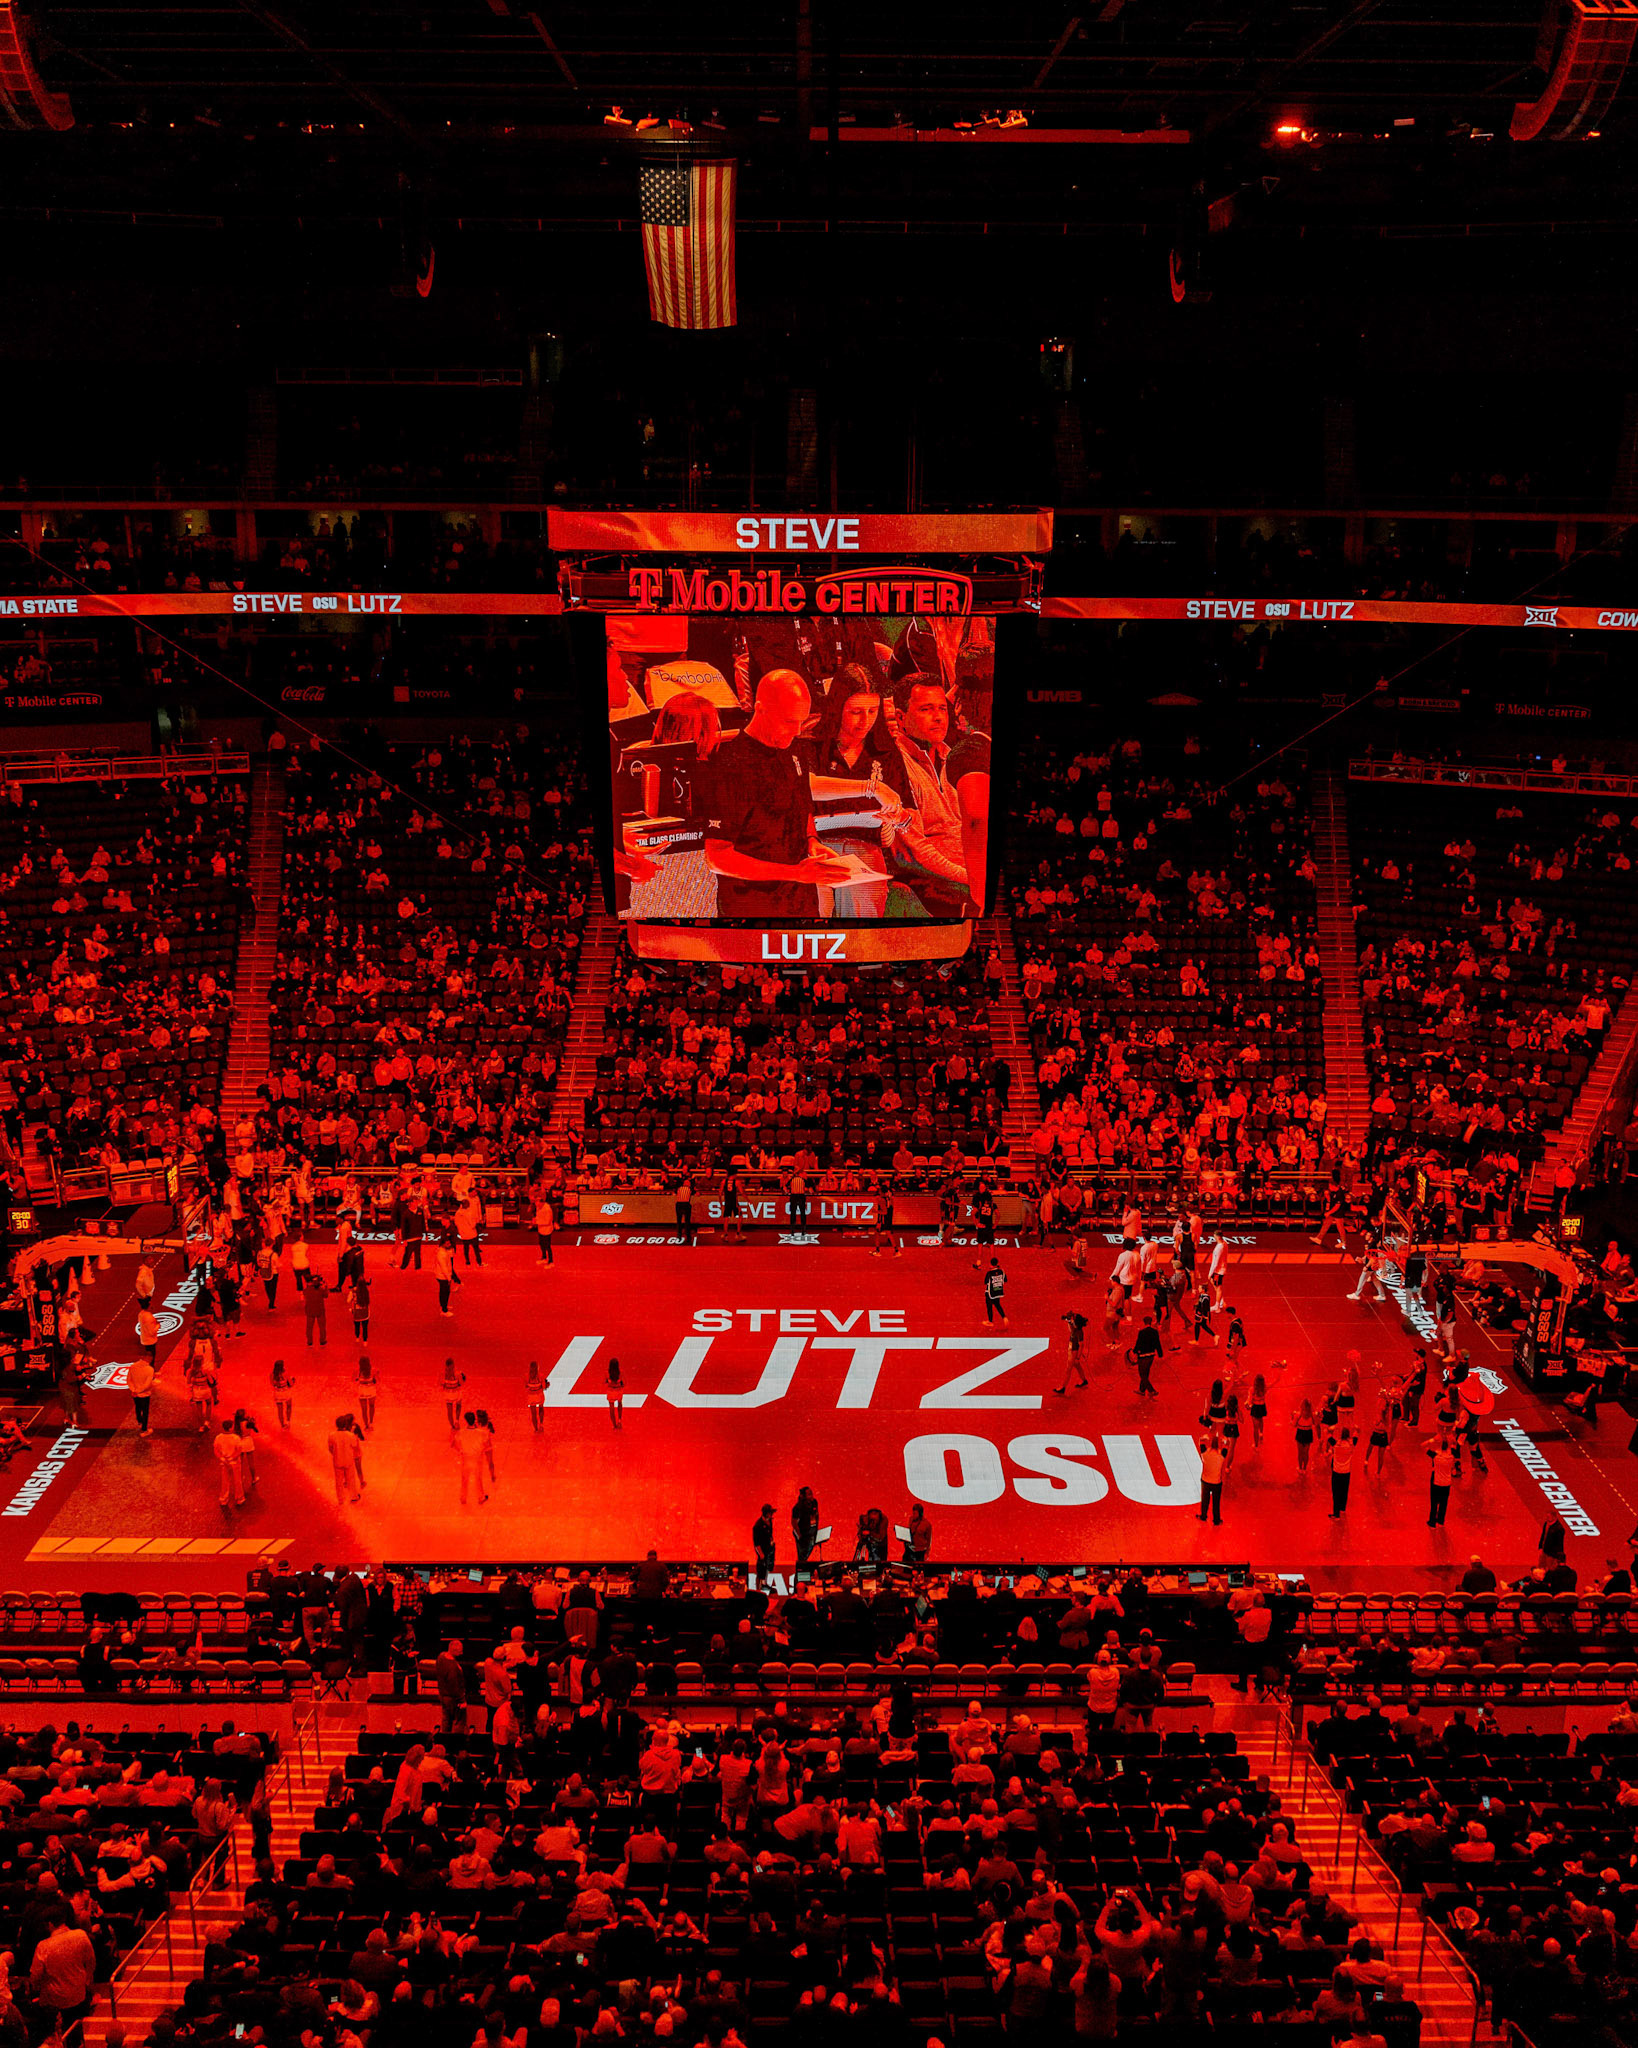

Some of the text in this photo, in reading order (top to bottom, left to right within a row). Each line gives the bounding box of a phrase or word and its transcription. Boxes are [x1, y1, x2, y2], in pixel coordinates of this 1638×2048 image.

[737, 518, 859, 549] STEVE
[669, 569, 806, 612] Mobile
[815, 581, 961, 613] CENTER
[23, 599, 78, 613] STATE
[233, 595, 402, 612] STEVE OSU LUTZ
[1187, 601, 1354, 619] STEVE OSU LUTZ
[413, 690, 451, 698] TOYOTA
[1027, 690, 1082, 702] UMB
[17, 696, 56, 707] Mobile
[59, 697, 98, 706] CENTER
[1507, 703, 1545, 716] Mobile
[1548, 708, 1588, 718] CENTER
[762, 933, 846, 959] LUTZ
[709, 1202, 776, 1218] SEVE
[821, 1202, 873, 1219] LUTZ
[981, 1207, 991, 1216] 23
[16, 1220, 28, 1229] 30
[1562, 1218, 1580, 1226] 20:00
[1564, 1227, 1577, 1235] 30
[626, 1236, 645, 1244] GO
[646, 1236, 665, 1244] GO
[41, 1305, 53, 1315] GO
[42, 1315, 54, 1325] GO
[693, 1310, 907, 1332] STEVE
[1538, 1311, 1551, 1322] GO
[42, 1325, 55, 1336] GO
[1537, 1321, 1550, 1331] GO
[1536, 1331, 1549, 1342] GO
[545, 1336, 1049, 1408] LUTZ
[1, 1427, 89, 1515] KANSAS CITY
[904, 1434, 1203, 1505] OSU
[1493, 1418, 1600, 1536] T-MOBILE CENTER
